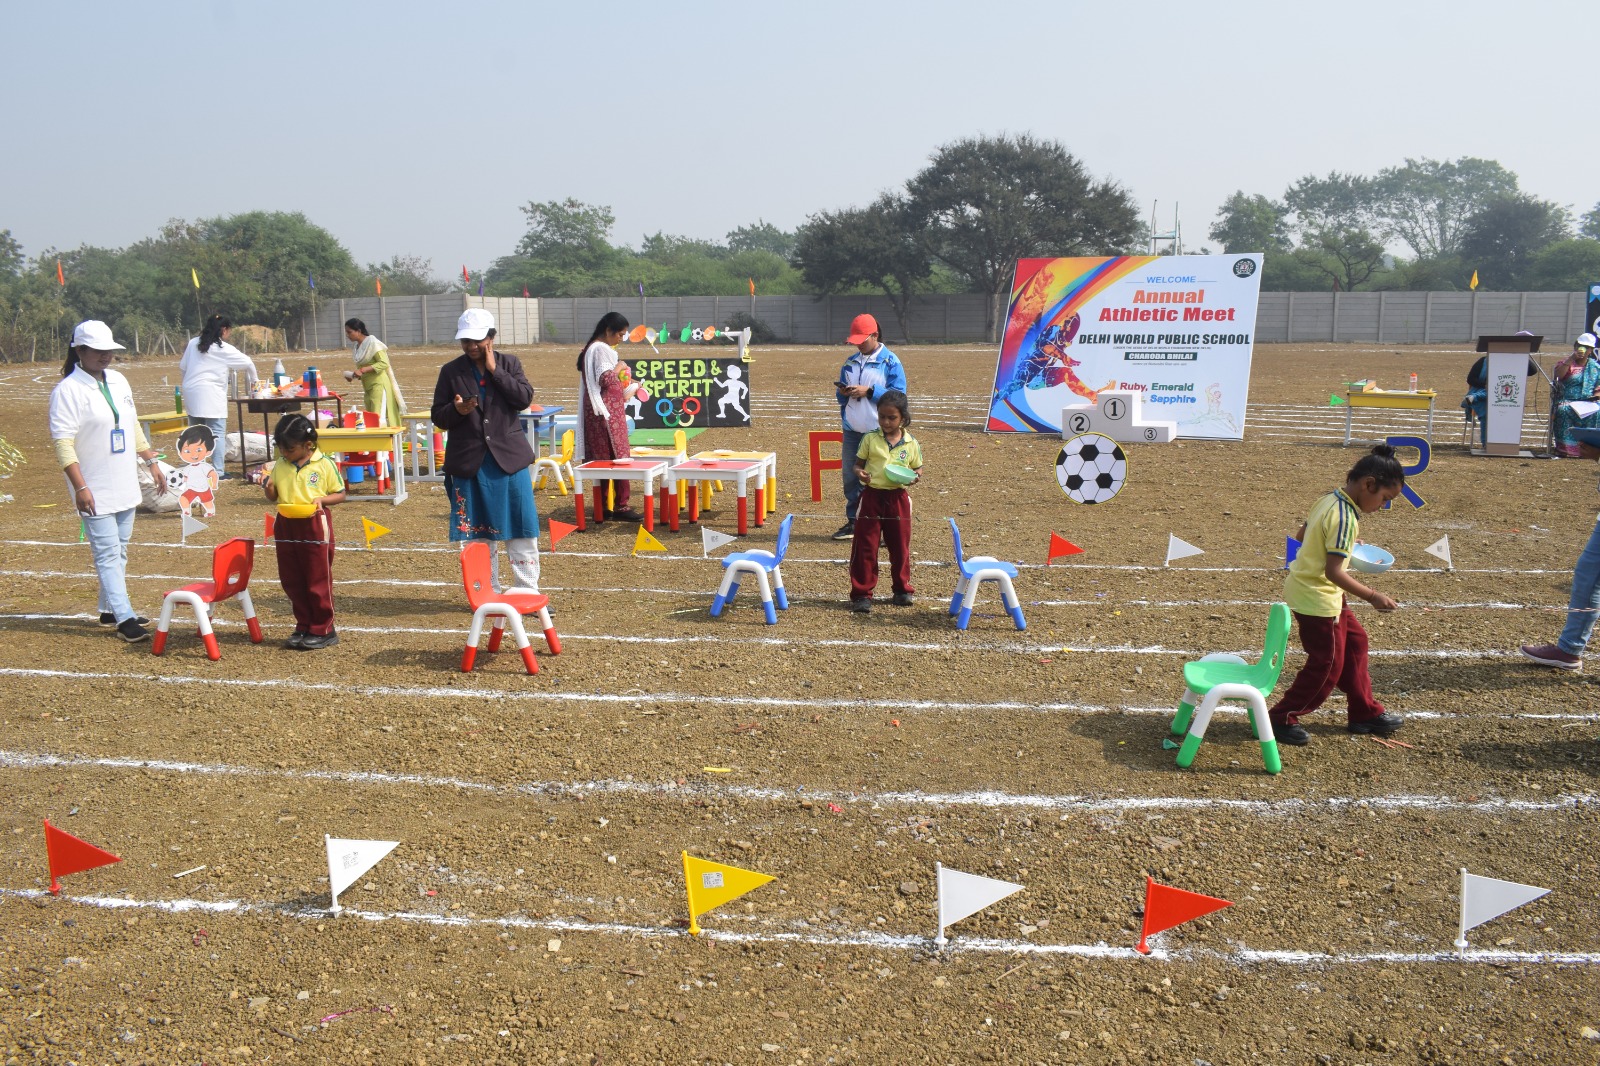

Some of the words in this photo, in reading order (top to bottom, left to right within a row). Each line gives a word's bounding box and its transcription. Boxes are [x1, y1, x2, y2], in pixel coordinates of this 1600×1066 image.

[1146, 276, 1197, 284] WELCOME
[1132, 289, 1205, 304] Annual
[1099, 307, 1179, 322] Athletic
[1183, 307, 1236, 322] Meet
[1078, 334, 1111, 345] DELHI
[1113, 334, 1156, 345] WORLD
[1157, 334, 1201, 345] PUBLIC
[1202, 334, 1250, 345] SCHOOL
[1128, 352, 1166, 360] CHARODA
[635, 359, 706, 379] SPEED
[710, 360, 722, 376] &
[642, 379, 714, 398] SPIRIT
[1119, 382, 1149, 393] Ruby,
[1151, 382, 1194, 392] Emerald
[1150, 394, 1197, 405] Sapphire
[1110, 401, 1118, 417] 1
[1074, 416, 1085, 432] 2
[1147, 428, 1154, 439] 3
